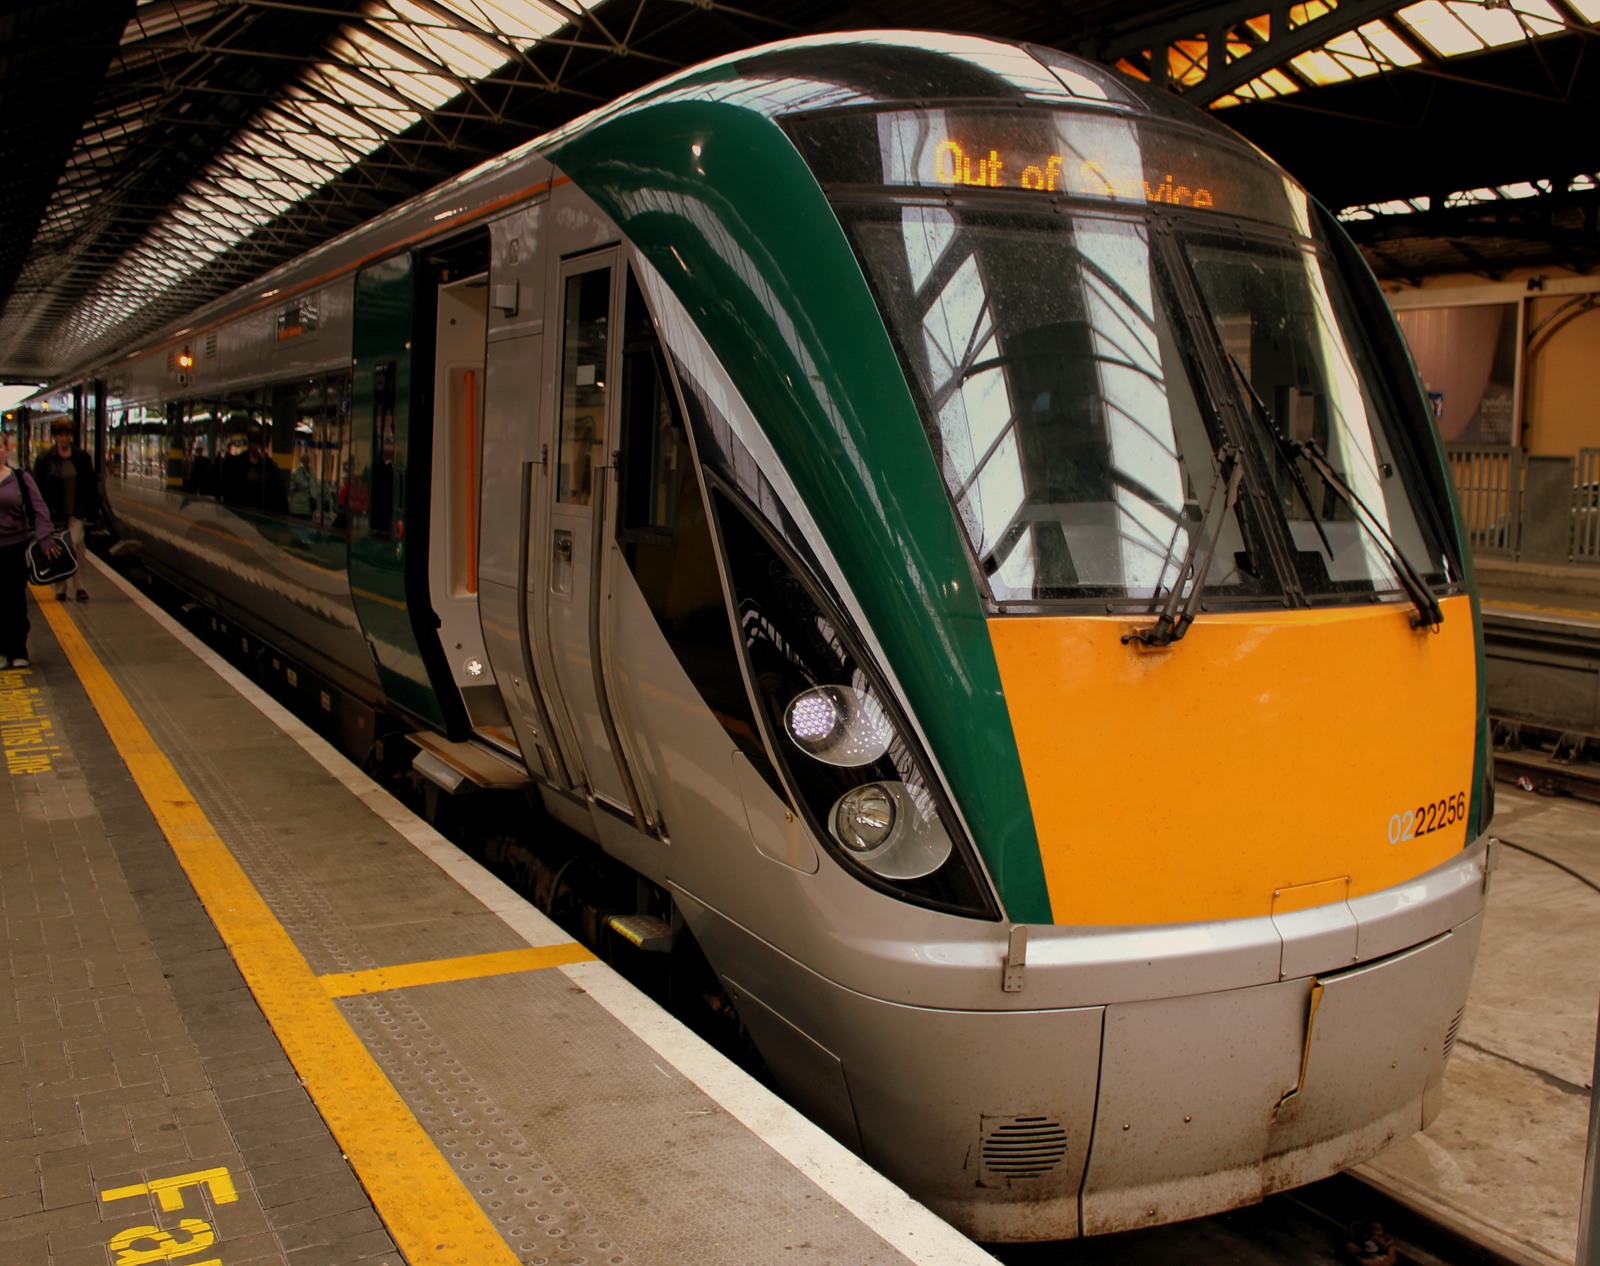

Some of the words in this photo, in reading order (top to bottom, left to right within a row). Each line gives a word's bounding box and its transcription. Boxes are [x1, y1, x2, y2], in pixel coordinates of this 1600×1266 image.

[935, 139, 1003, 187] Out
[1021, 155, 1062, 191] of
[1, 719, 55, 746] This
[5, 746, 62, 774] Line
[1387, 791, 1465, 846] 0222256
[101, 1166, 239, 1266] Fa
